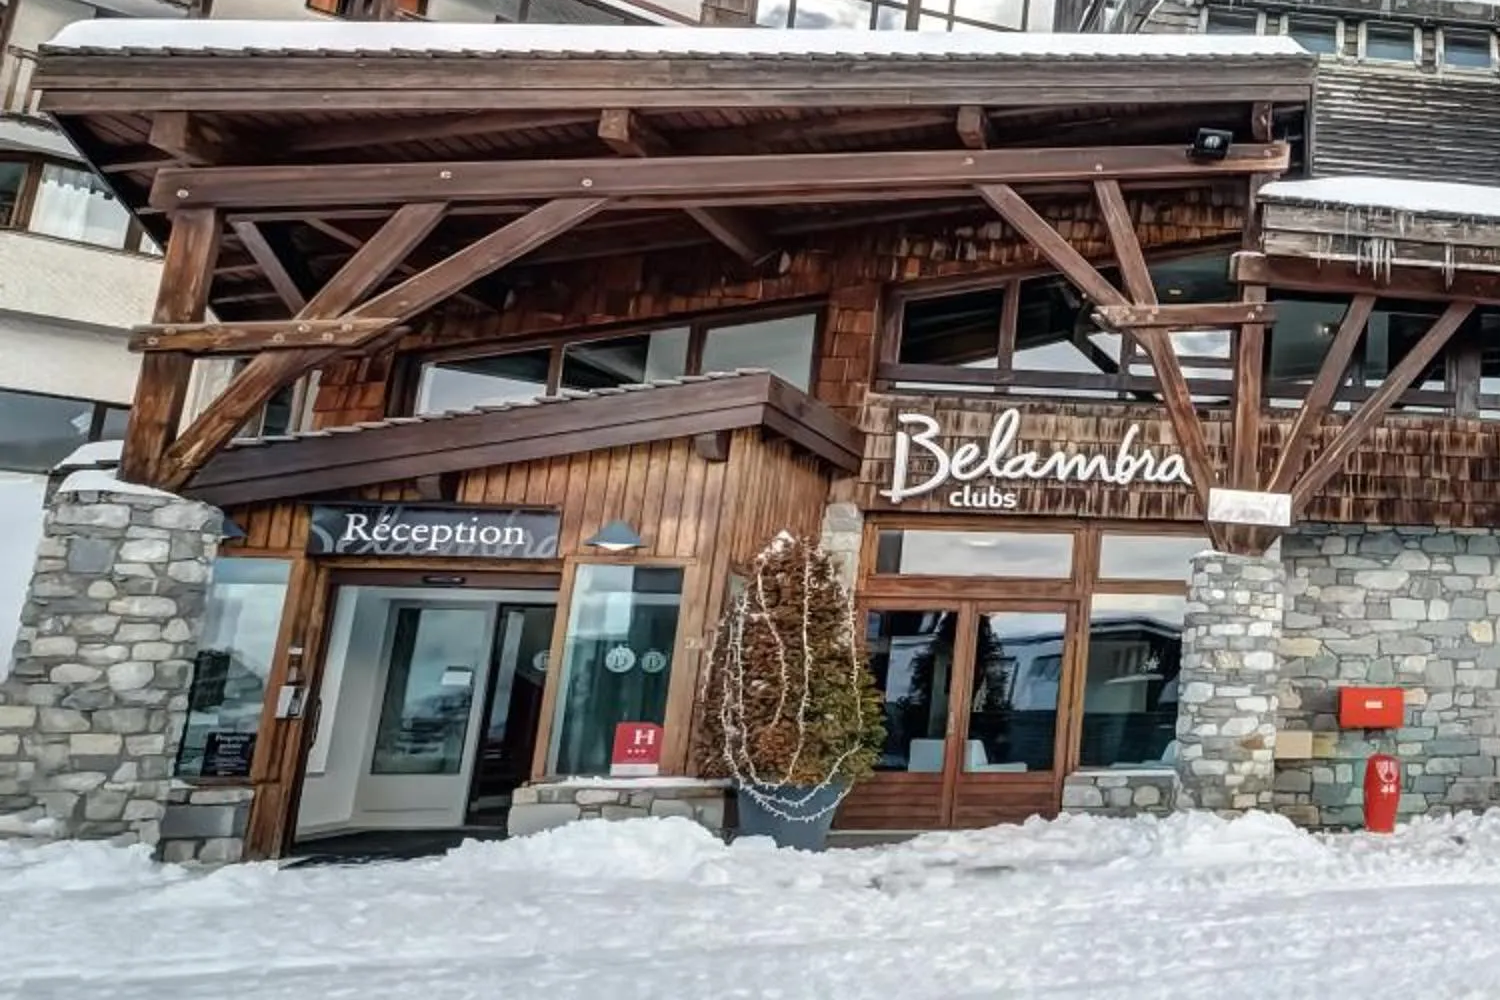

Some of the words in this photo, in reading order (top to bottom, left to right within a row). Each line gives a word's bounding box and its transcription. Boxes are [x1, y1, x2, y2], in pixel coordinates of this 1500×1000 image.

[880, 407, 1193, 503] Belambra
[949, 486, 1017, 509] clubs
[342, 512, 526, 550] Réception
